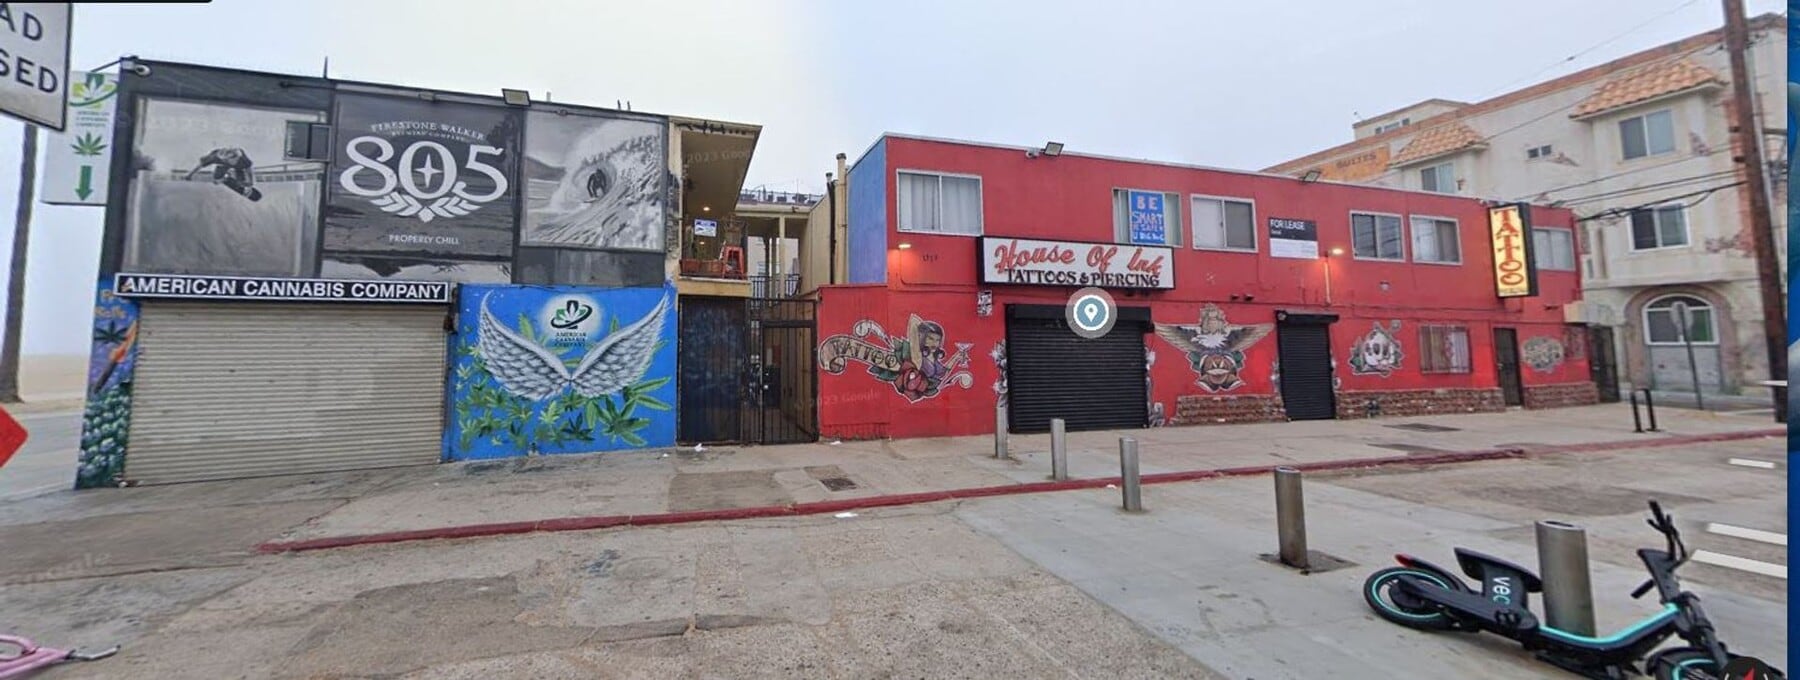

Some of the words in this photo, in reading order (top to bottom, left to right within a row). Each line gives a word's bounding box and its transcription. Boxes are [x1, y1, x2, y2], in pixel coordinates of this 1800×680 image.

[371, 121, 438, 133] FIRESTONE
[441, 123, 485, 140] WALKER
[340, 136, 508, 202] 805
[1270, 219, 1284, 229] FOR
[1285, 220, 1305, 231] LEASE
[389, 234, 433, 245] PROPERLY
[435, 236, 460, 245] CHILL
[1494, 207, 1524, 286] TATTOO
[994, 239, 1076, 274] House
[1086, 245, 1118, 273] Of
[1127, 248, 1164, 277] Ink
[123, 277, 237, 295] AMERICAN
[243, 280, 345, 298] CANNABIS
[351, 283, 443, 300] COMPANY
[1005, 268, 1077, 284] TATTOOS
[1079, 274, 1088, 284] &
[1092, 272, 1160, 288] PIERCING
